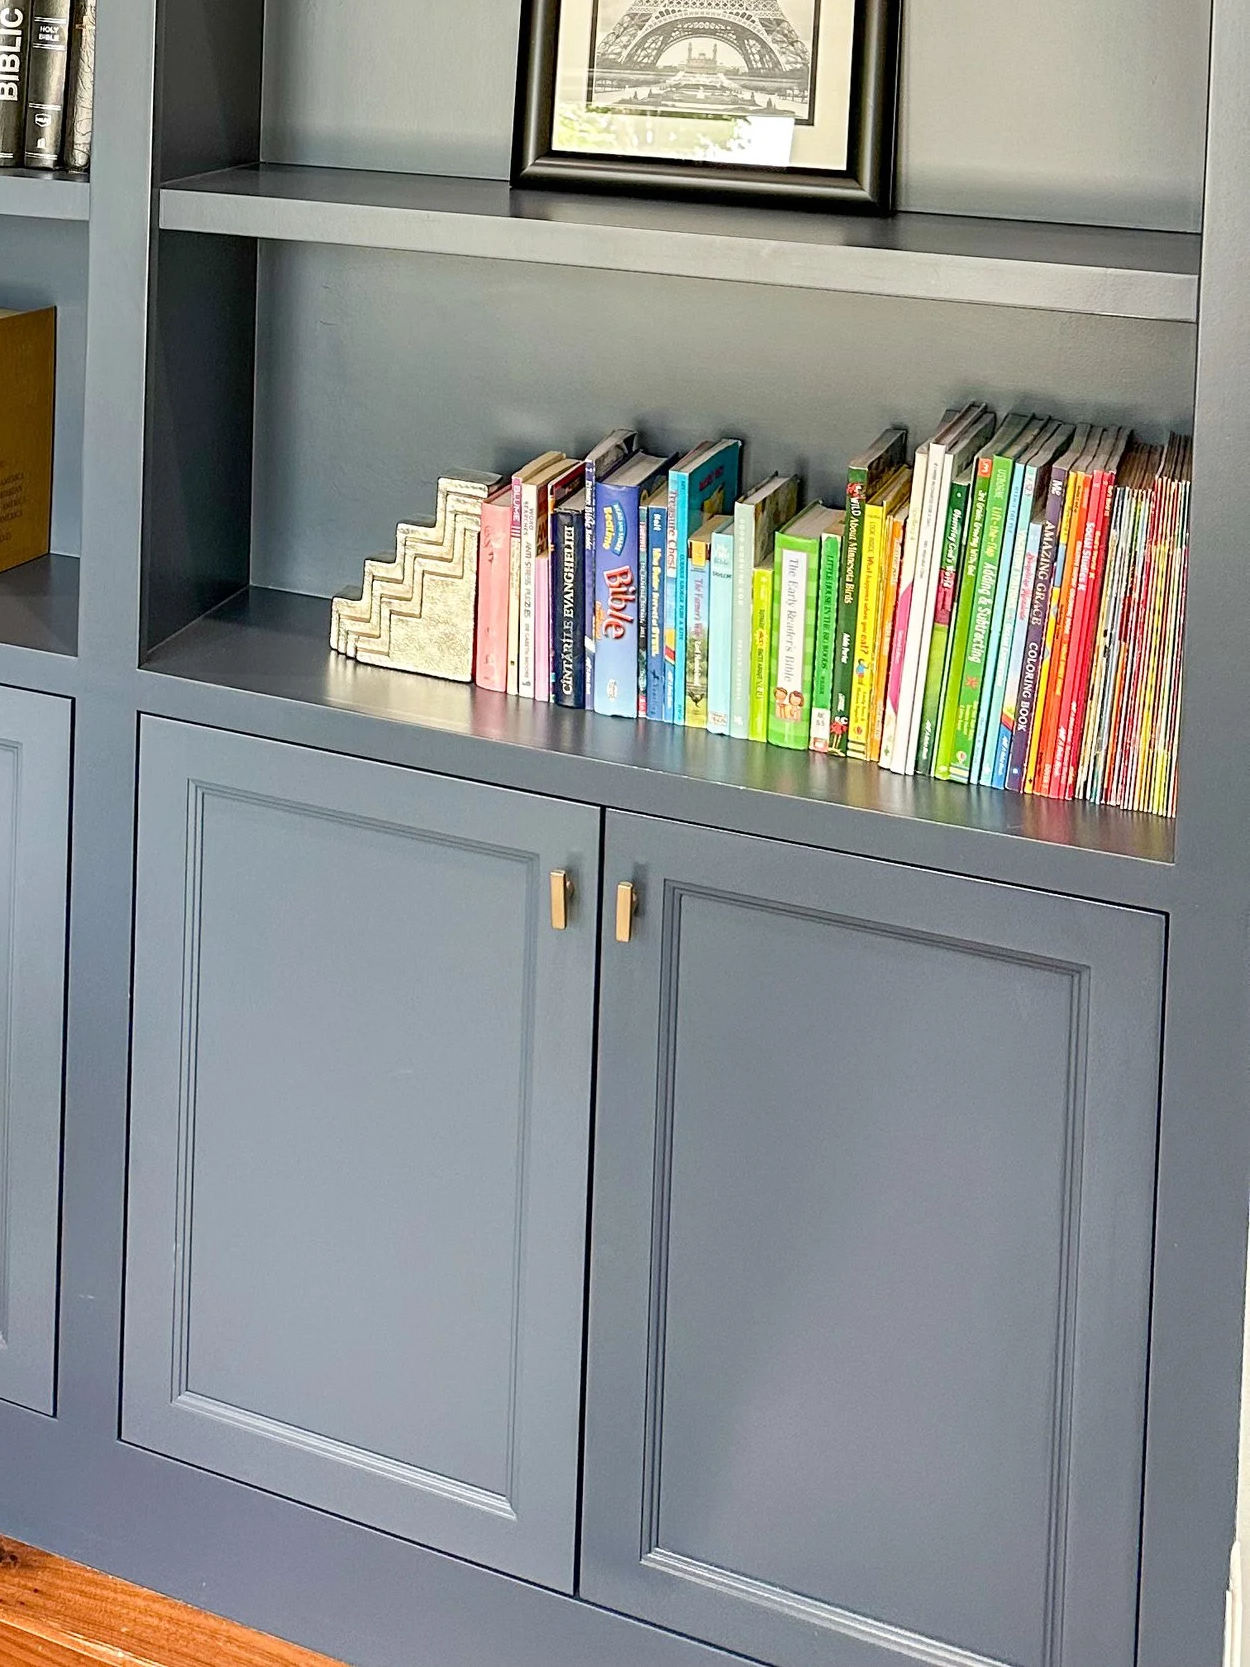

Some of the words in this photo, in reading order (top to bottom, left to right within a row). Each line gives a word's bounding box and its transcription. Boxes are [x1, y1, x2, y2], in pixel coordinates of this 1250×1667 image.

[40, 25, 59, 33] HOLY
[993, 469, 1006, 499] USBORNE
[668, 490, 678, 537] Treasure
[850, 497, 863, 516] WILD
[603, 507, 615, 550] Bedtime
[848, 516, 859, 540] About
[946, 509, 962, 542] Observing
[1084, 522, 1095, 549] Social
[668, 539, 676, 570] Chest
[846, 542, 857, 582] Minnesota
[945, 544, 956, 563] God's
[1036, 520, 1055, 580] AMAZING
[789, 558, 799, 577] The
[942, 565, 955, 587] World
[980, 562, 998, 596] Adding
[1079, 551, 1092, 583] Studies
[602, 565, 636, 639] Bible
[785, 581, 798, 607] Early
[843, 583, 854, 604] Birds
[1031, 582, 1047, 625] GRACE
[785, 609, 796, 652] Reader's
[968, 606, 992, 663] Subtracting
[783, 656, 794, 682] Bible
[1019, 642, 1039, 698] COLORING
[1017, 700, 1031, 732] BOOK
